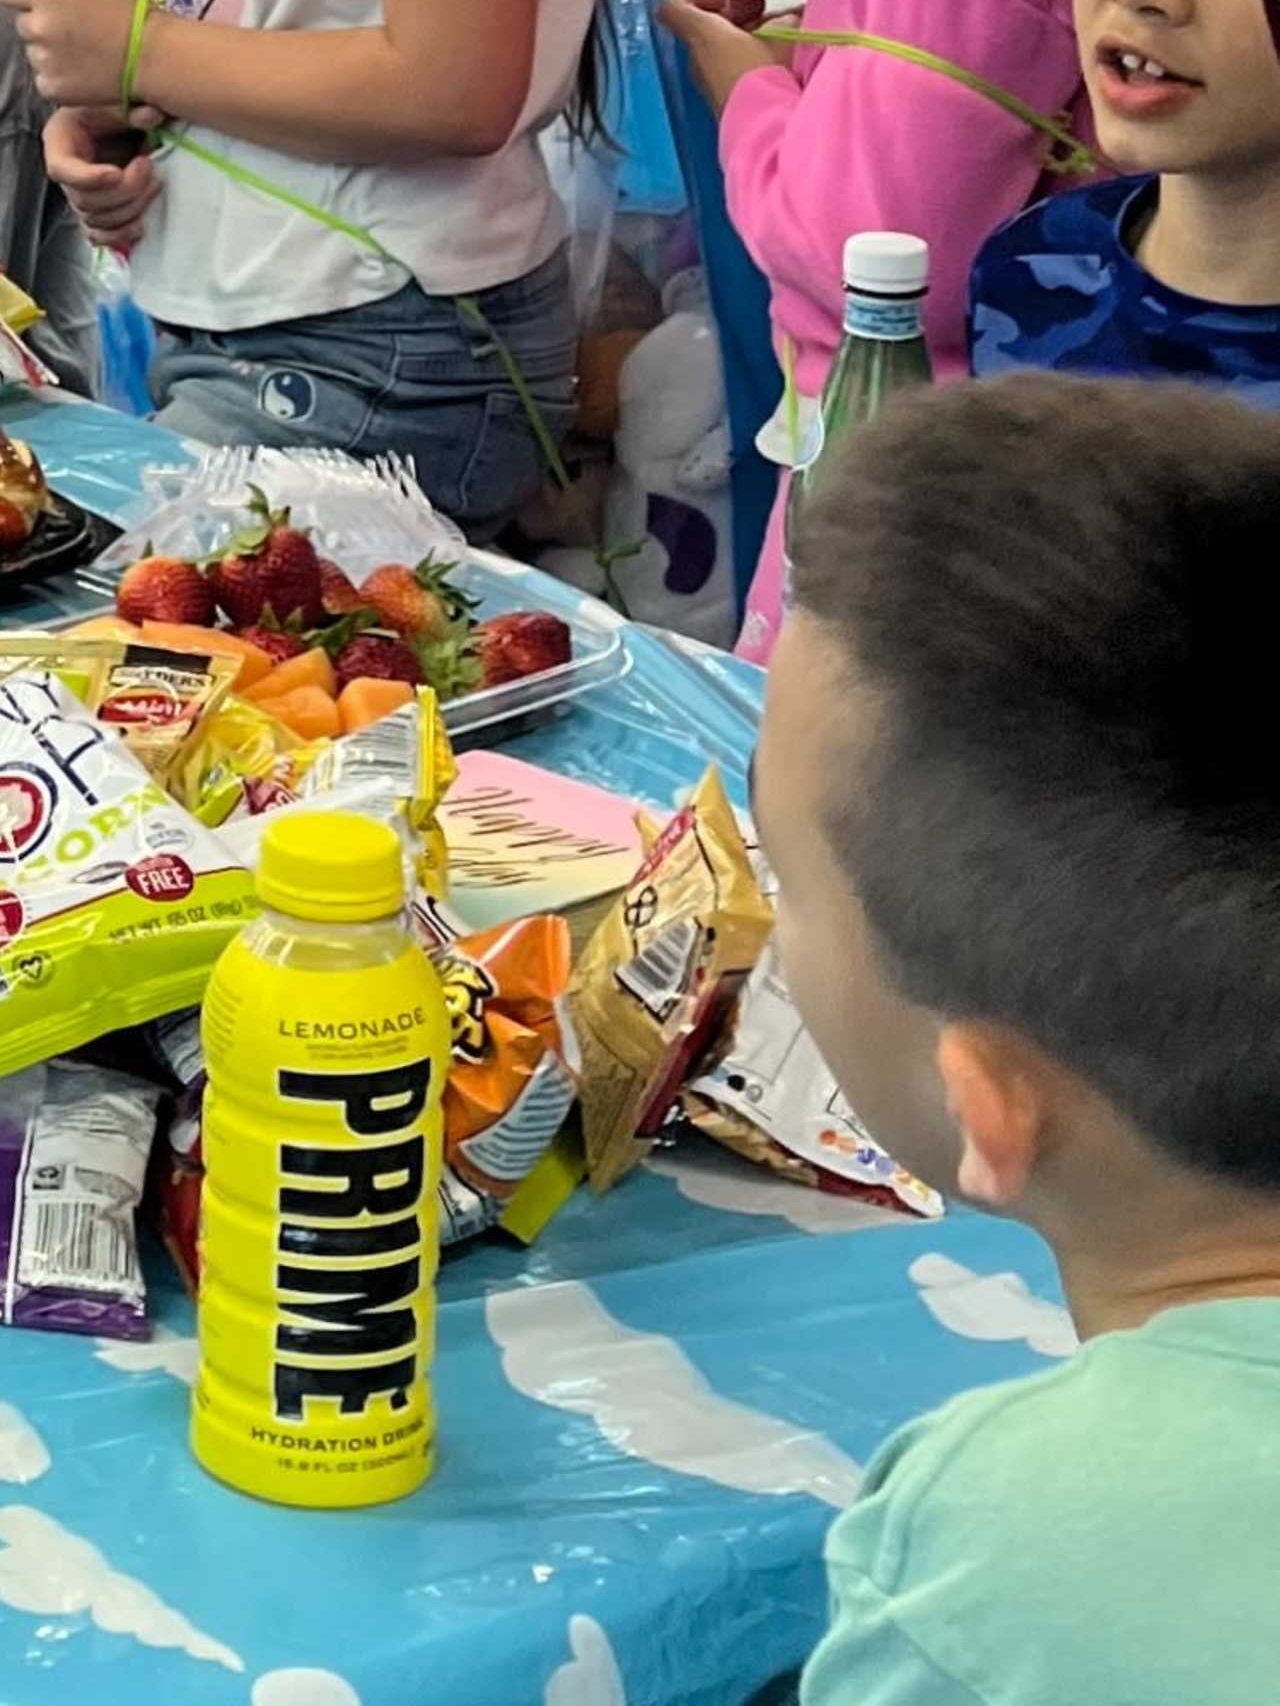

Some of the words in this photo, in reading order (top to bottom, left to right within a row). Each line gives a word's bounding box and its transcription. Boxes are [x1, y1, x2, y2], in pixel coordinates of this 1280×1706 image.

[140, 868, 192, 896] FREE
[279, 1007, 426, 1040] LEMONADE
[274, 1058, 431, 1422] PRIME
[251, 1425, 377, 1452] HYDRATION
